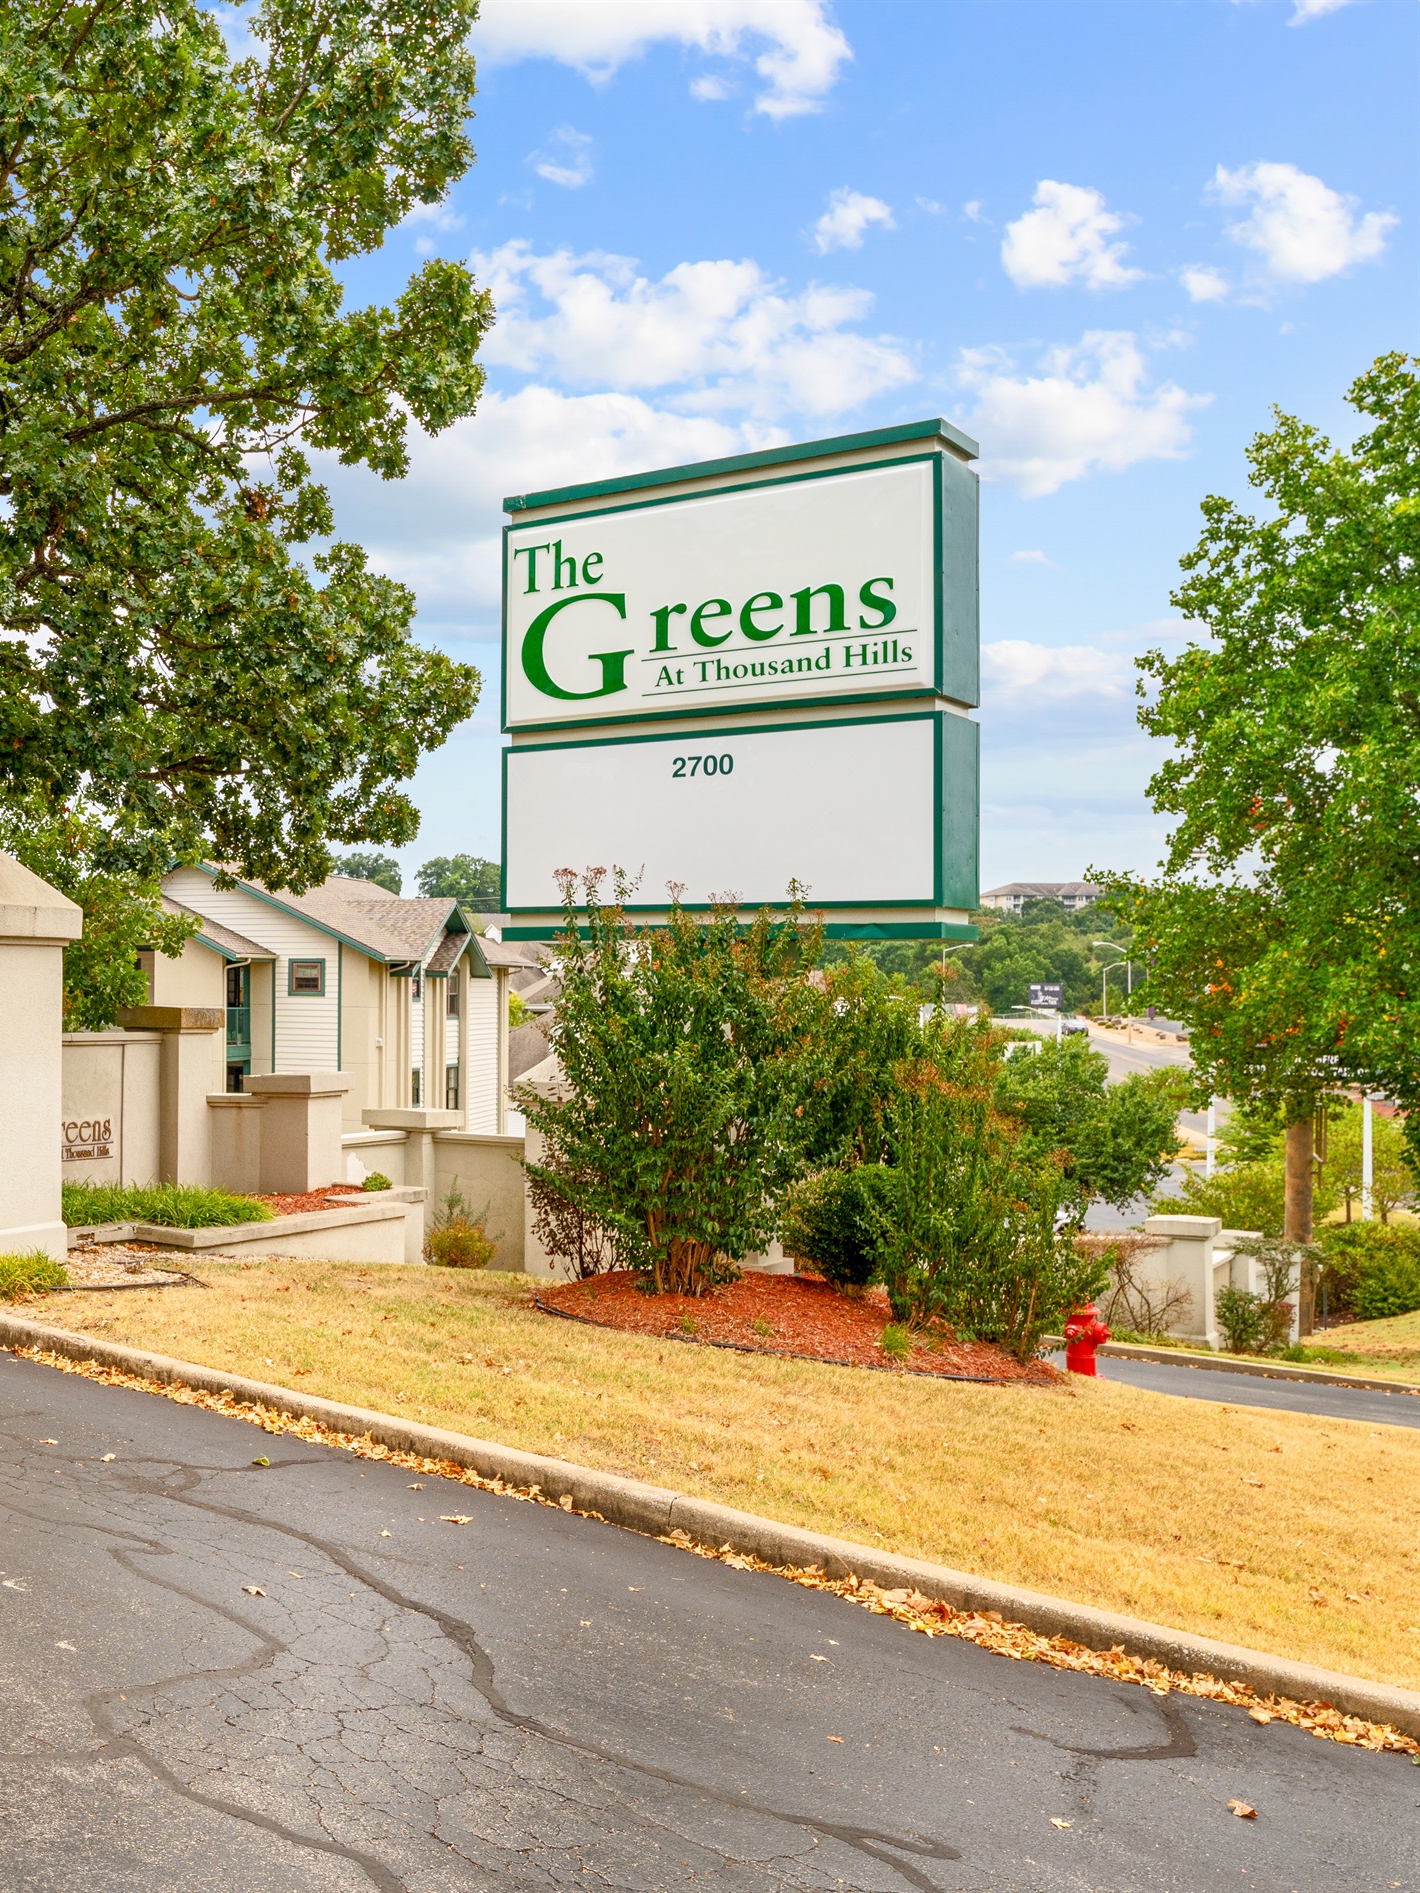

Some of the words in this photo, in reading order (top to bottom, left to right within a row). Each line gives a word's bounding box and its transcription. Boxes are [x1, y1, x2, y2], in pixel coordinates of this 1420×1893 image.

[513, 539, 604, 595] The
[521, 576, 898, 700] Greens
[654, 664, 684, 688] At
[693, 647, 831, 687] Thousand
[843, 639, 913, 668] Hills
[672, 754, 734, 778] 2700
[61, 1119, 112, 1143] eens
